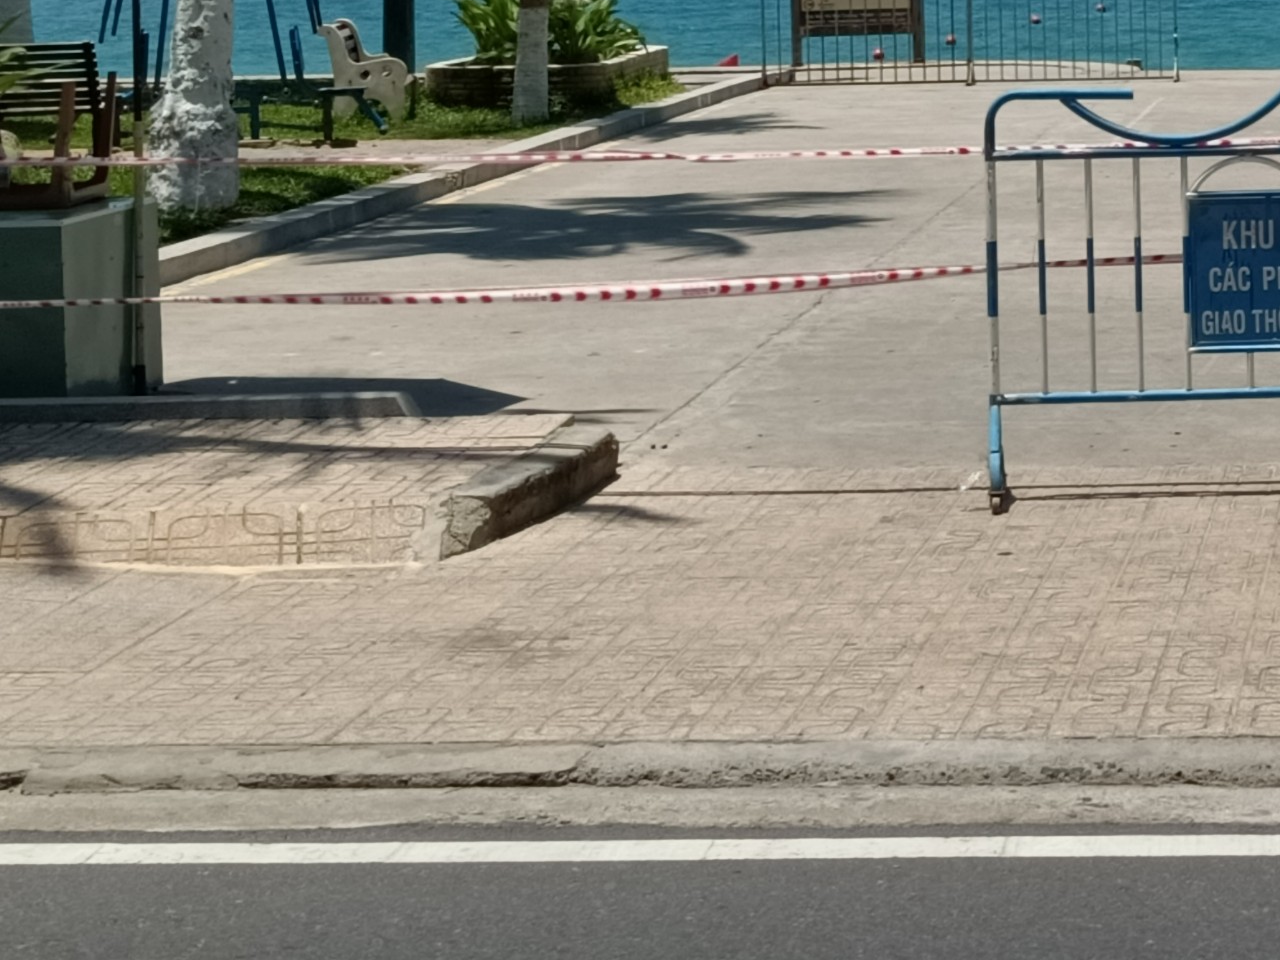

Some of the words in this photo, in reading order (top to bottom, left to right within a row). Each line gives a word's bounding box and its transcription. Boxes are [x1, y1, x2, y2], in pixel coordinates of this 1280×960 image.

[1222, 219, 1274, 250] KHU
[1208, 261, 1251, 292] CÁC
[1202, 309, 1246, 335] GIAO
